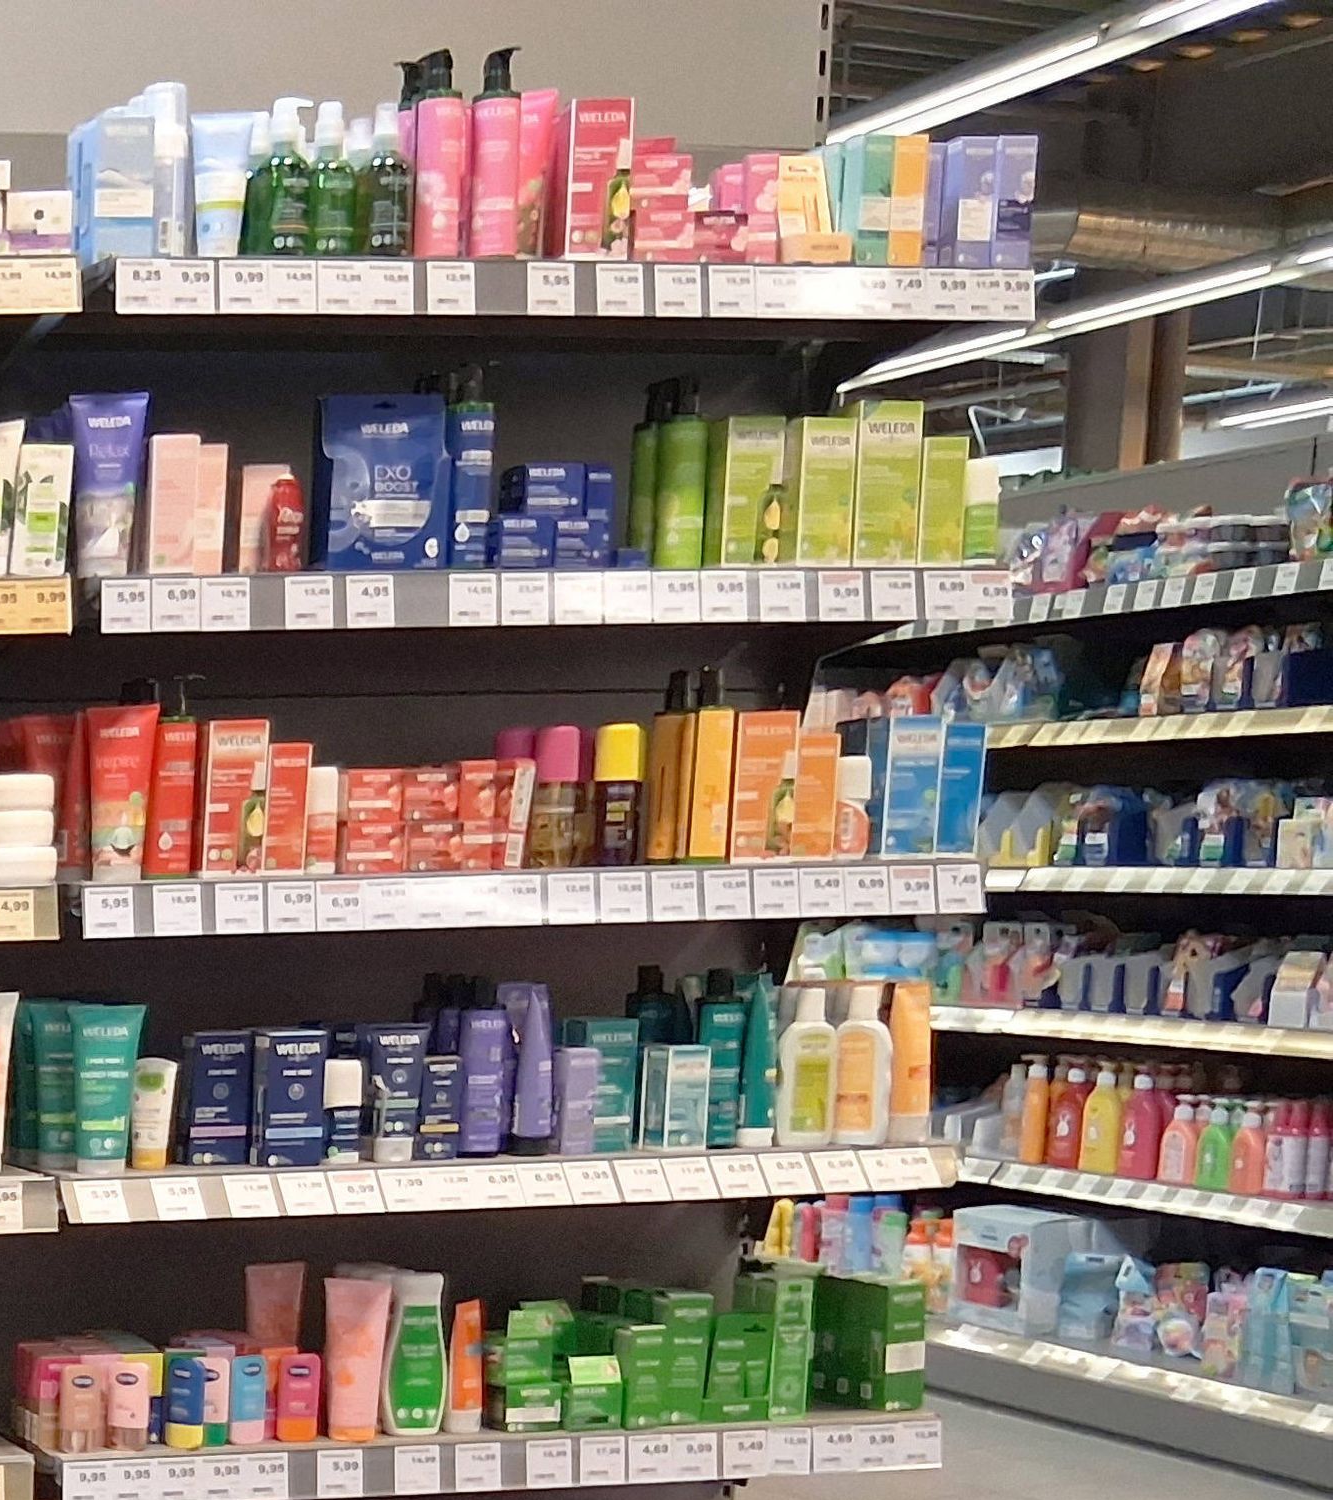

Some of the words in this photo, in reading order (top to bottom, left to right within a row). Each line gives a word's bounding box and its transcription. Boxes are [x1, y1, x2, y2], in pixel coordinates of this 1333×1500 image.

[579, 111, 627, 122] WELEDA
[87, 416, 131, 428] WELEDA
[361, 422, 409, 434] WELEDA
[867, 421, 915, 434] WELEDA
[811, 435, 851, 446] WELEDA
[100, 726, 139, 738] WELEDA
[217, 734, 261, 747] WELEDA
[83, 1026, 128, 1038] WELEDA
[379, 1034, 420, 1046] WELEDA
[201, 1042, 245, 1056] WELEDA
[276, 1042, 321, 1056] WELEDA
